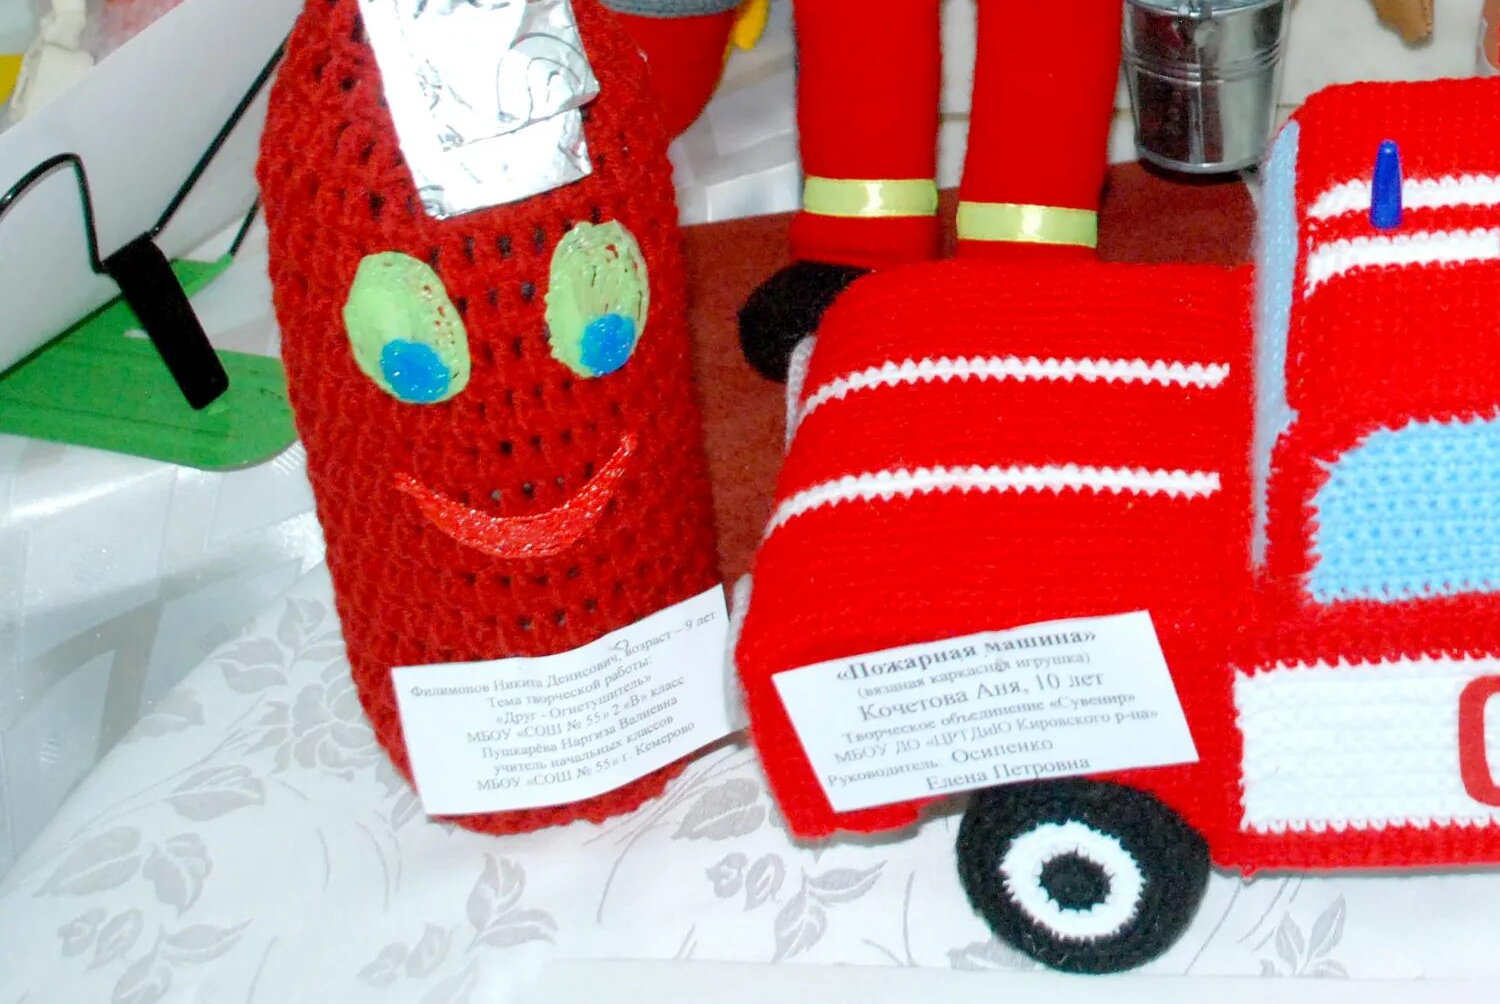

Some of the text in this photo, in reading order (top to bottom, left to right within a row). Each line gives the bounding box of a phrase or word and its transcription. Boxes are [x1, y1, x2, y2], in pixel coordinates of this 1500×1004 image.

[410, 684, 490, 697] Филимонов
[494, 679, 543, 691] Никита
[547, 655, 622, 688] Денисович,
[626, 631, 671, 656] возраст
[685, 619, 693, 630] 9
[696, 611, 716, 626] лет
[837, 630, 1096, 681] «Пожарная машина»
[857, 676, 925, 699] (вязаная
[1016, 652, 1091, 670] игрушка)
[487, 656, 654, 708] Тема творческой работы:
[550, 676, 652, 719] Огнетушитель»
[858, 672, 1104, 722] Кочетова Аня, 10 лет
[467, 729, 511, 743] МБОУ
[517, 723, 562, 738] «СОШ
[567, 719, 581, 732] №
[613, 703, 621, 716] 2
[651, 676, 685, 696] класс
[481, 696, 678, 760] Пушкарёва Наргиза Валиевна
[842, 693, 1136, 744] Творческое объединение «Сувенир»
[477, 777, 521, 791] МБОУ
[526, 771, 572, 785] «СОШ
[577, 764, 592, 777] №
[622, 752, 632, 762] г.
[635, 722, 695, 756] Кемерово
[494, 715, 674, 776] учитель начальных классов
[834, 744, 887, 764] МБОУ
[895, 738, 921, 755] ДО
[1016, 712, 1111, 732] Кировского
[1115, 709, 1158, 724] р-на»
[828, 739, 1053, 788] Руководитель: Осипенко
[926, 757, 1091, 790] Елена Петровна
